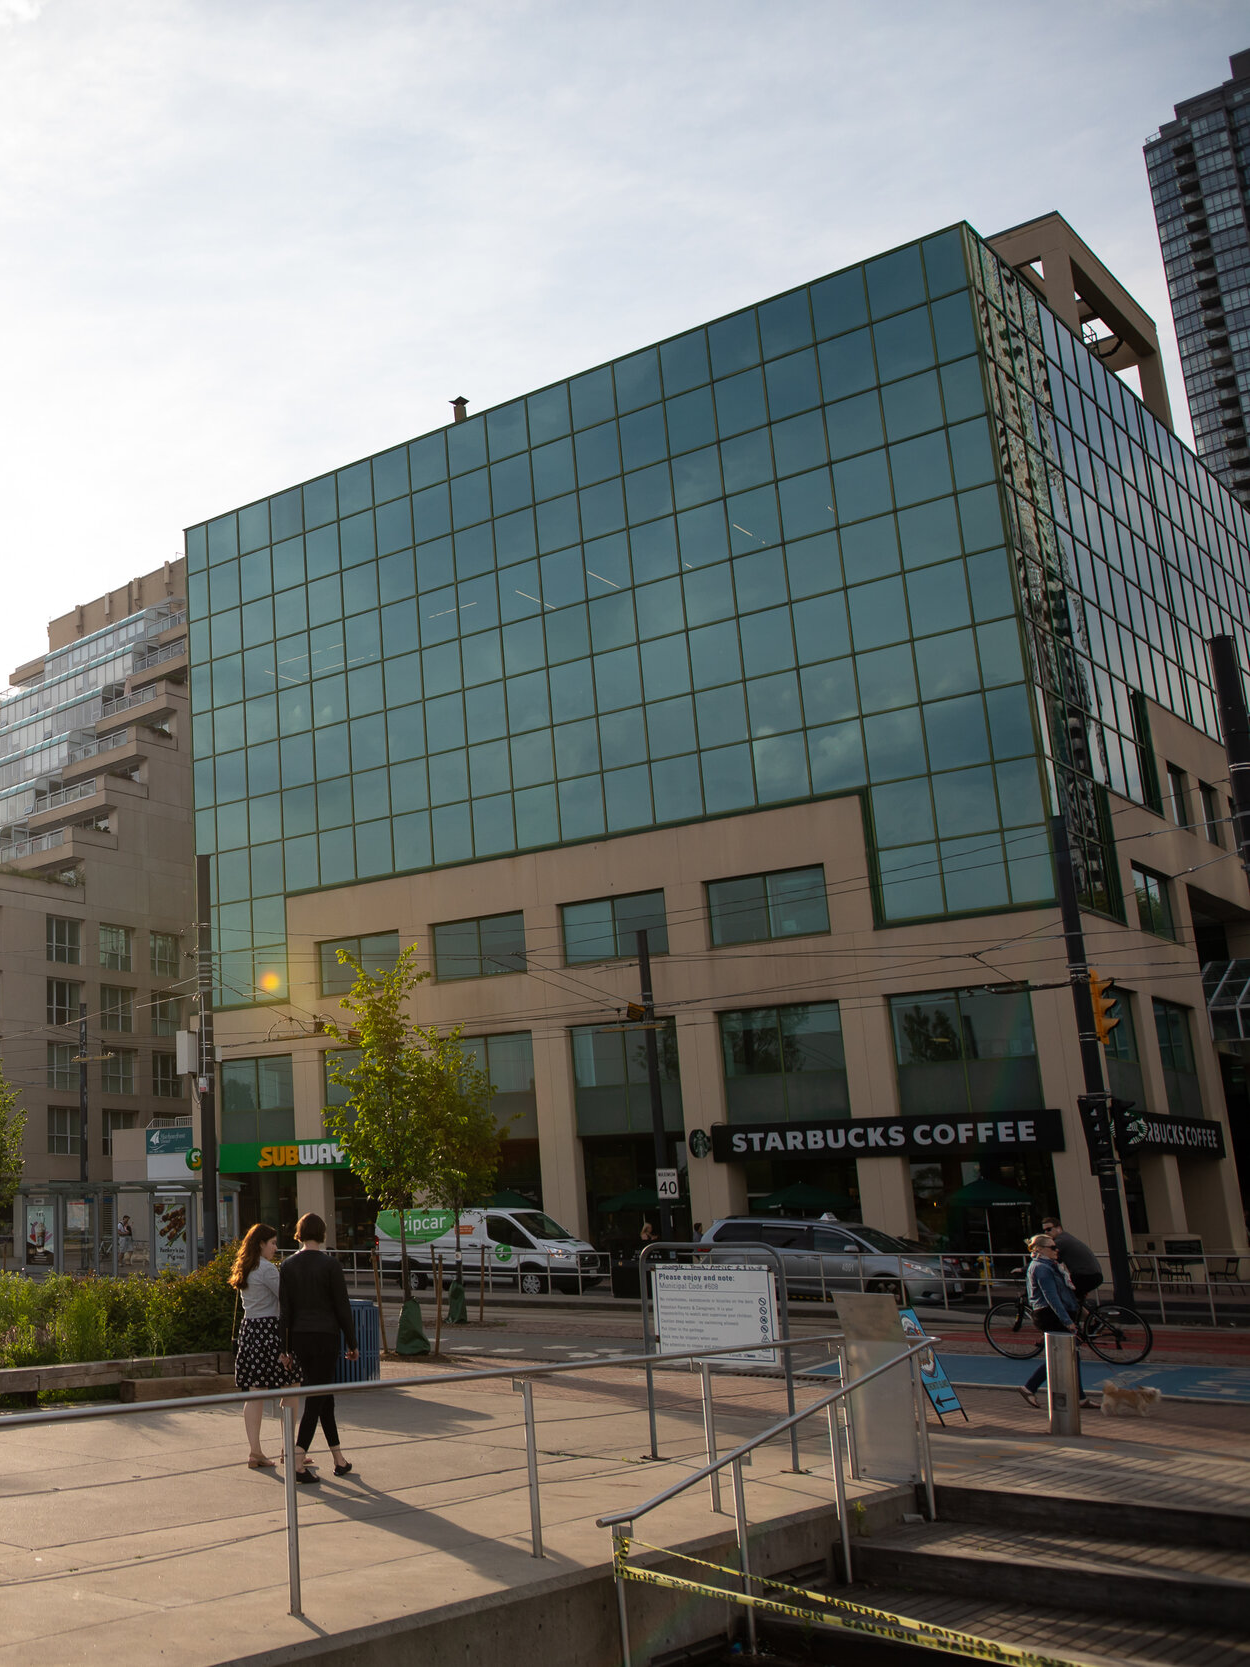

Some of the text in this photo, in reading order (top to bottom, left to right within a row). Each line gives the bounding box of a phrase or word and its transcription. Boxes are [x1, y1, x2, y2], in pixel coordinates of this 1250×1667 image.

[731, 1120, 1037, 1153] STARBUCKS COFFEE
[1146, 1121, 1218, 1149] RBUCKS COFFEE
[257, 1143, 351, 1169] SUBWAY
[659, 1181, 677, 1195] 40
[658, 1273, 682, 1281] Please
[682, 1274, 702, 1283] enjoy
[659, 1282, 687, 1290] Municipal
[752, 1599, 825, 1623] CAUTION
[841, 1617, 919, 1643] CAUTION
